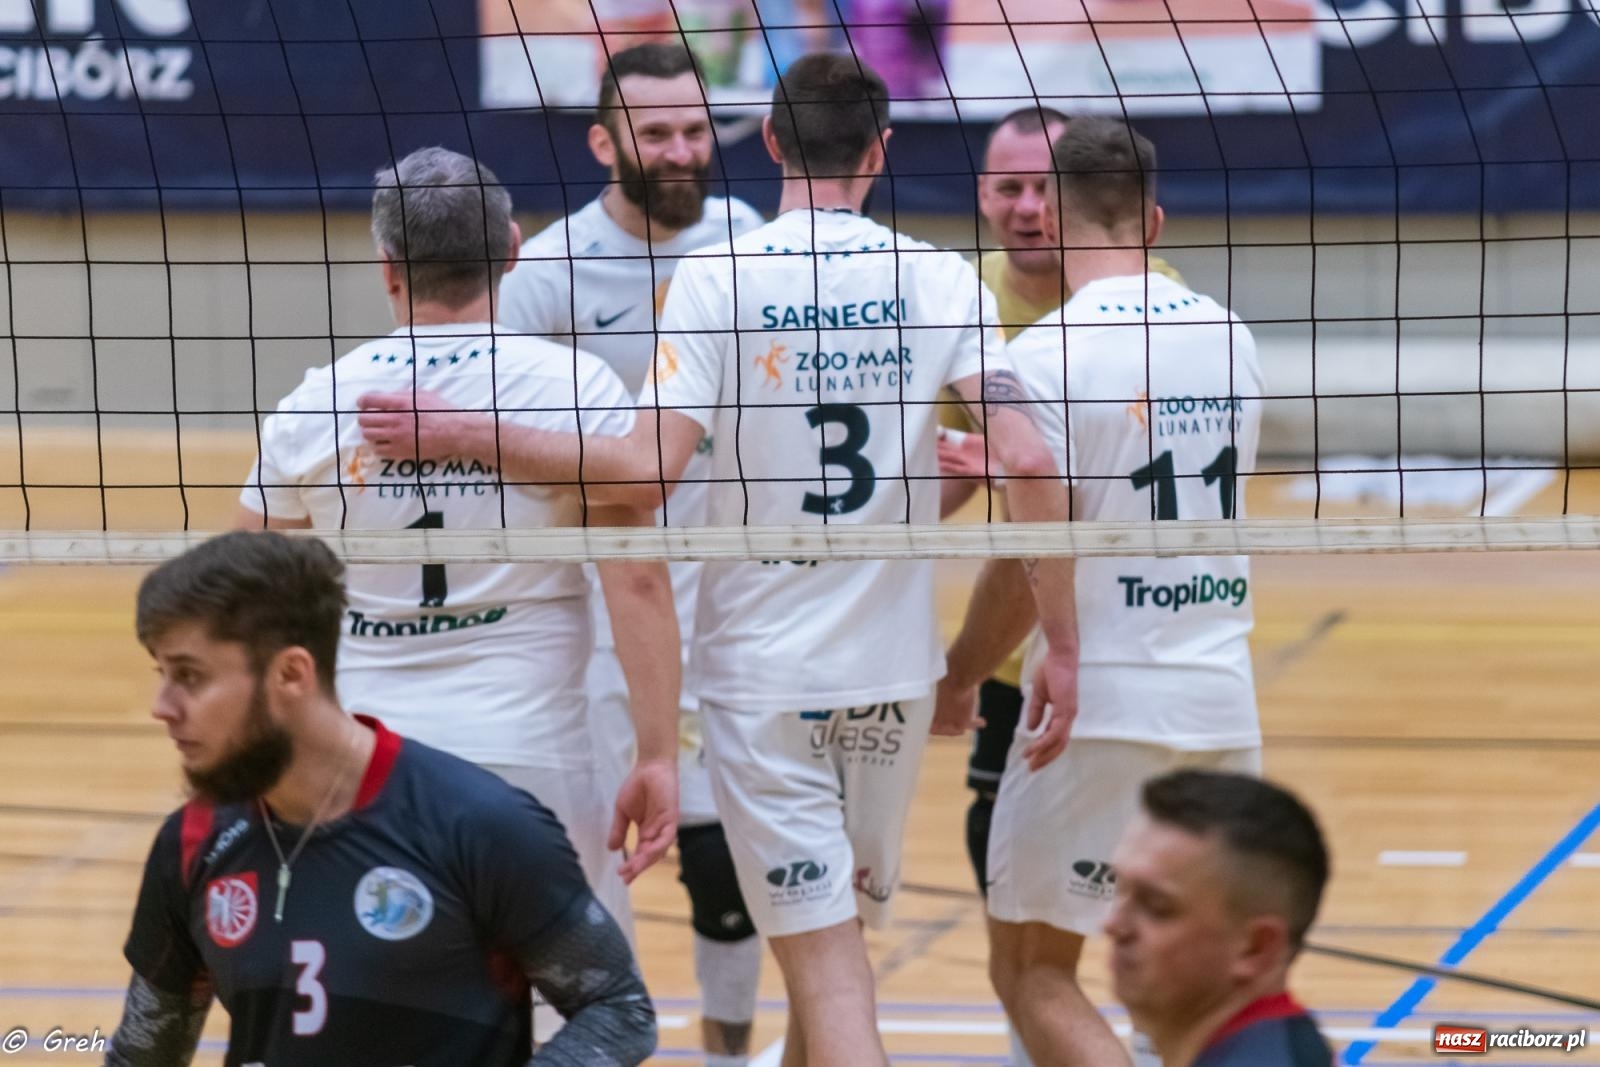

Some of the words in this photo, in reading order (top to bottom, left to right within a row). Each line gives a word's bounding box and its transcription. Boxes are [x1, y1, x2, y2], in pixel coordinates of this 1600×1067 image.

[762, 298, 907, 329] SARNECKI
[796, 369, 912, 392] LUNATYCY
[380, 459, 436, 477] ZOO
[801, 402, 876, 515] 3
[1130, 445, 1237, 521] 11
[1118, 574, 1247, 612] TropiDog
[810, 714, 904, 758] glass
[291, 940, 328, 1035] 3
